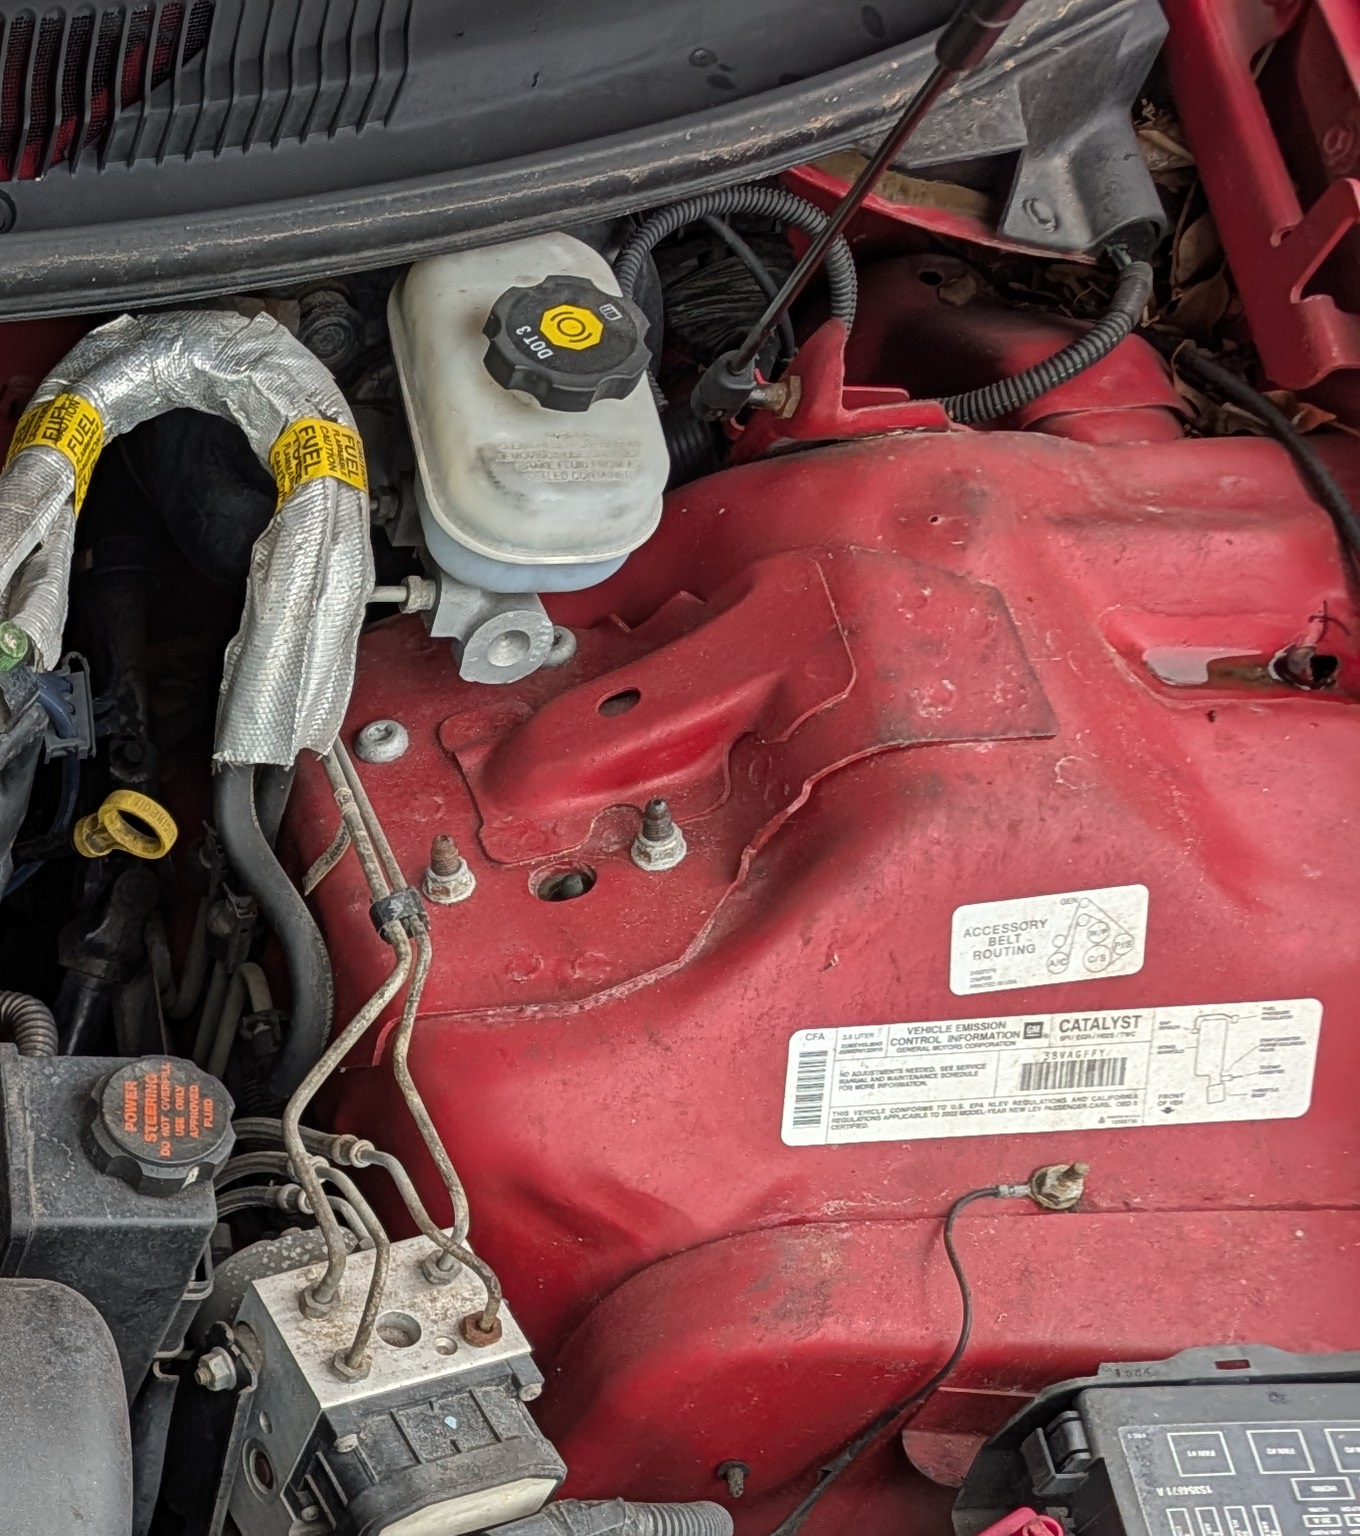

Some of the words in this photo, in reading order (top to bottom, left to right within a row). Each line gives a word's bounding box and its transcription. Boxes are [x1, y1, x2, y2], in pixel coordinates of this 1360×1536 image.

[516, 325, 531, 335] 3
[523, 336, 554, 359] DOT
[67, 413, 95, 456] FUEL
[299, 425, 321, 475] FUEL
[319, 425, 337, 472] CAUTION
[341, 433, 359, 479] FUEL
[963, 918, 1048, 938] ACCESSORY
[988, 933, 1022, 947] BELT
[973, 944, 1036, 960] ROUTING
[907, 1024, 953, 1035] VEHICLE
[955, 1021, 1006, 1032] EMISSION
[1026, 1024, 1040, 1035] GM
[1059, 1015, 1142, 1033] CATALYST
[805, 1033, 825, 1041] CFA
[891, 1035, 942, 1047] CONTROL
[948, 1031, 1020, 1043] INFORMATION
[896, 1045, 929, 1053] GENERAL
[962, 1040, 1016, 1050] CORPORATION
[160, 1062, 172, 1110] OVERFILL
[124, 1081, 137, 1132] POWER
[144, 1073, 157, 1142] STEERING
[175, 1085, 184, 1110] ONLY
[190, 1085, 200, 1138] APPROVED
[204, 1098, 213, 1128] FLUID
[161, 1116, 170, 1137] NOT
[175, 1117, 185, 1136] USE
[160, 1141, 171, 1157] DO
